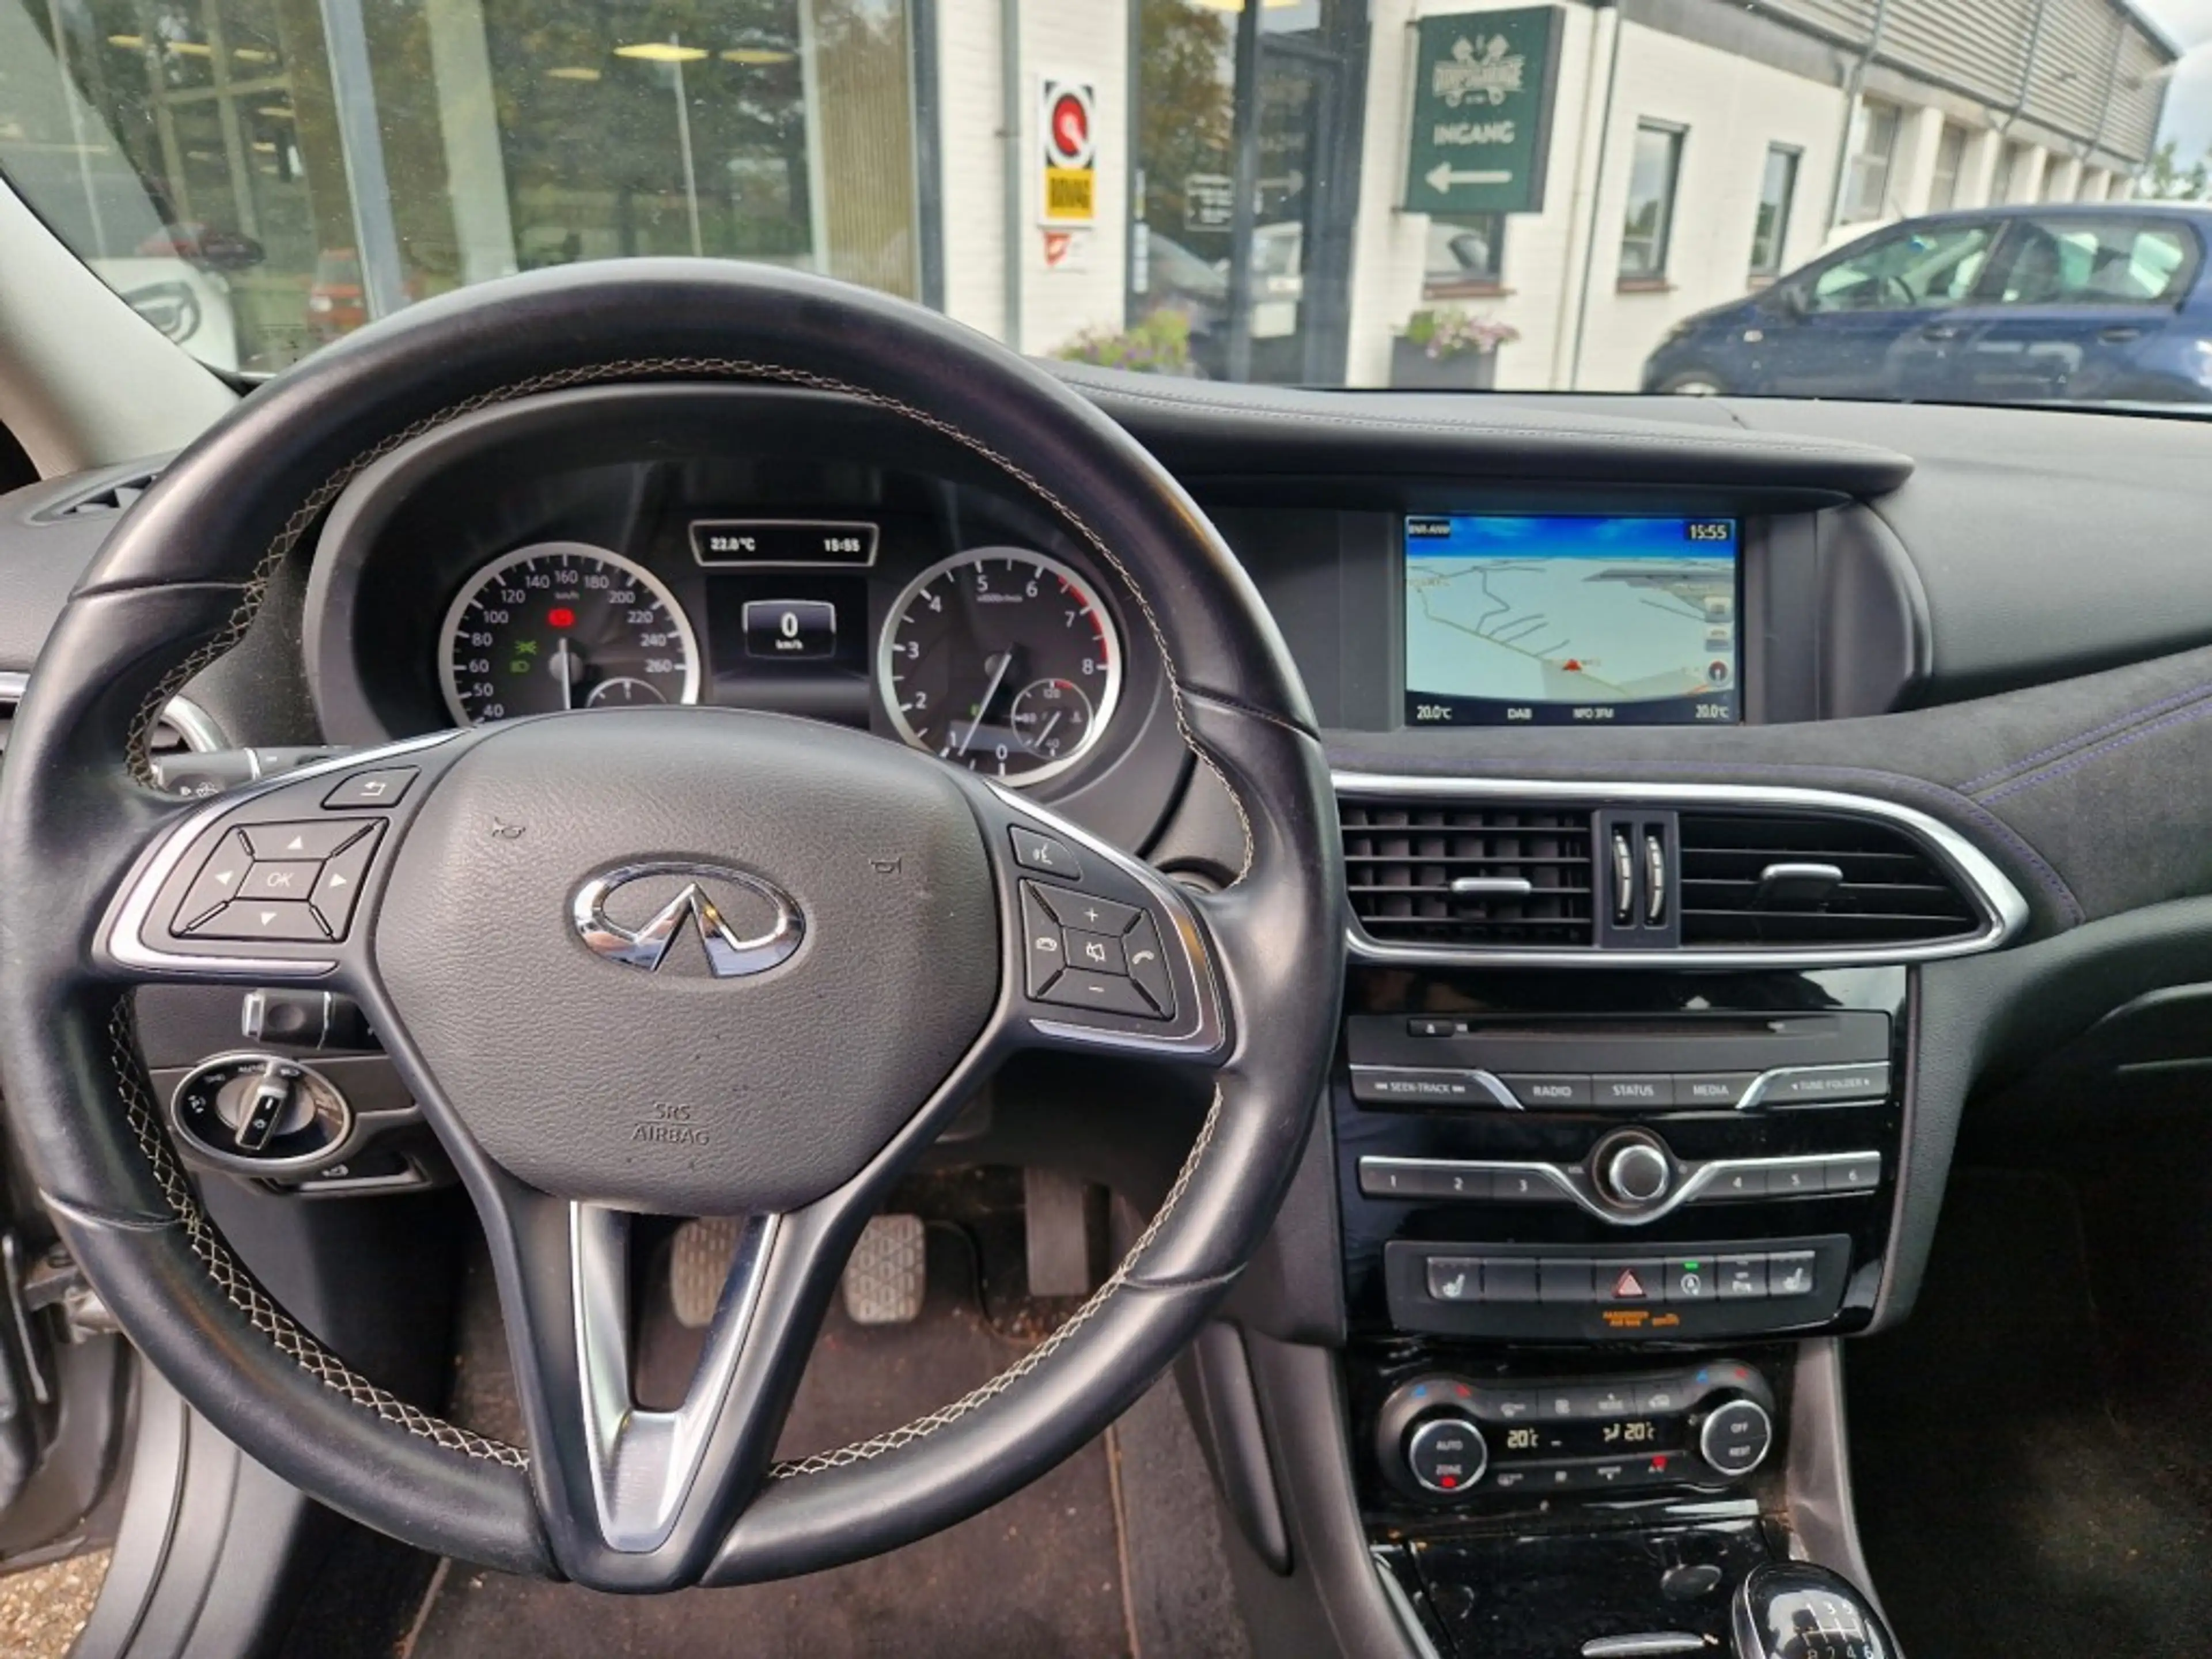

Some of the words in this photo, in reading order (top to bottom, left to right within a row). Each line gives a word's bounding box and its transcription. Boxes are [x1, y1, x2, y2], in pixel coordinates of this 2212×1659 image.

[1690, 524, 1727, 540] 15:55
[525, 575, 550, 589] 140
[554, 570, 578, 584] 160
[584, 575, 609, 589] 180
[978, 575, 988, 592] 5
[501, 588, 525, 603] 120
[1026, 581, 1037, 597] 6
[608, 590, 635, 604] 200
[929, 596, 942, 612] 4
[483, 611, 509, 624] 100
[627, 611, 653, 624] 220
[1065, 611, 1076, 627] 7
[781, 612, 798, 638] 0
[472, 632, 493, 646] 80
[641, 633, 667, 646] 240
[908, 642, 919, 658] 3
[469, 659, 489, 673] 60
[646, 658, 673, 673] 260
[1082, 658, 1094, 675] 8
[473, 683, 494, 696] 50
[915, 693, 927, 709] 2
[483, 704, 505, 718] 40
[1507, 707, 1533, 719] DAB
[950, 731, 957, 745] 1
[995, 744, 1008, 762] 0
[267, 872, 295, 888] OK
[1532, 1085, 1573, 1097] RADIO
[1611, 1084, 1655, 1096] STATUS
[1692, 1085, 1729, 1096] MEDIA
[654, 1101, 691, 1120] SRS
[632, 1124, 710, 1146] AIRBAG
[1391, 1174, 1397, 1188] 1
[1848, 1169, 1858, 1182] 6
[1454, 1176, 1464, 1192] 2
[1519, 1179, 1528, 1192] 3
[1436, 1440, 1464, 1451] AUTO
